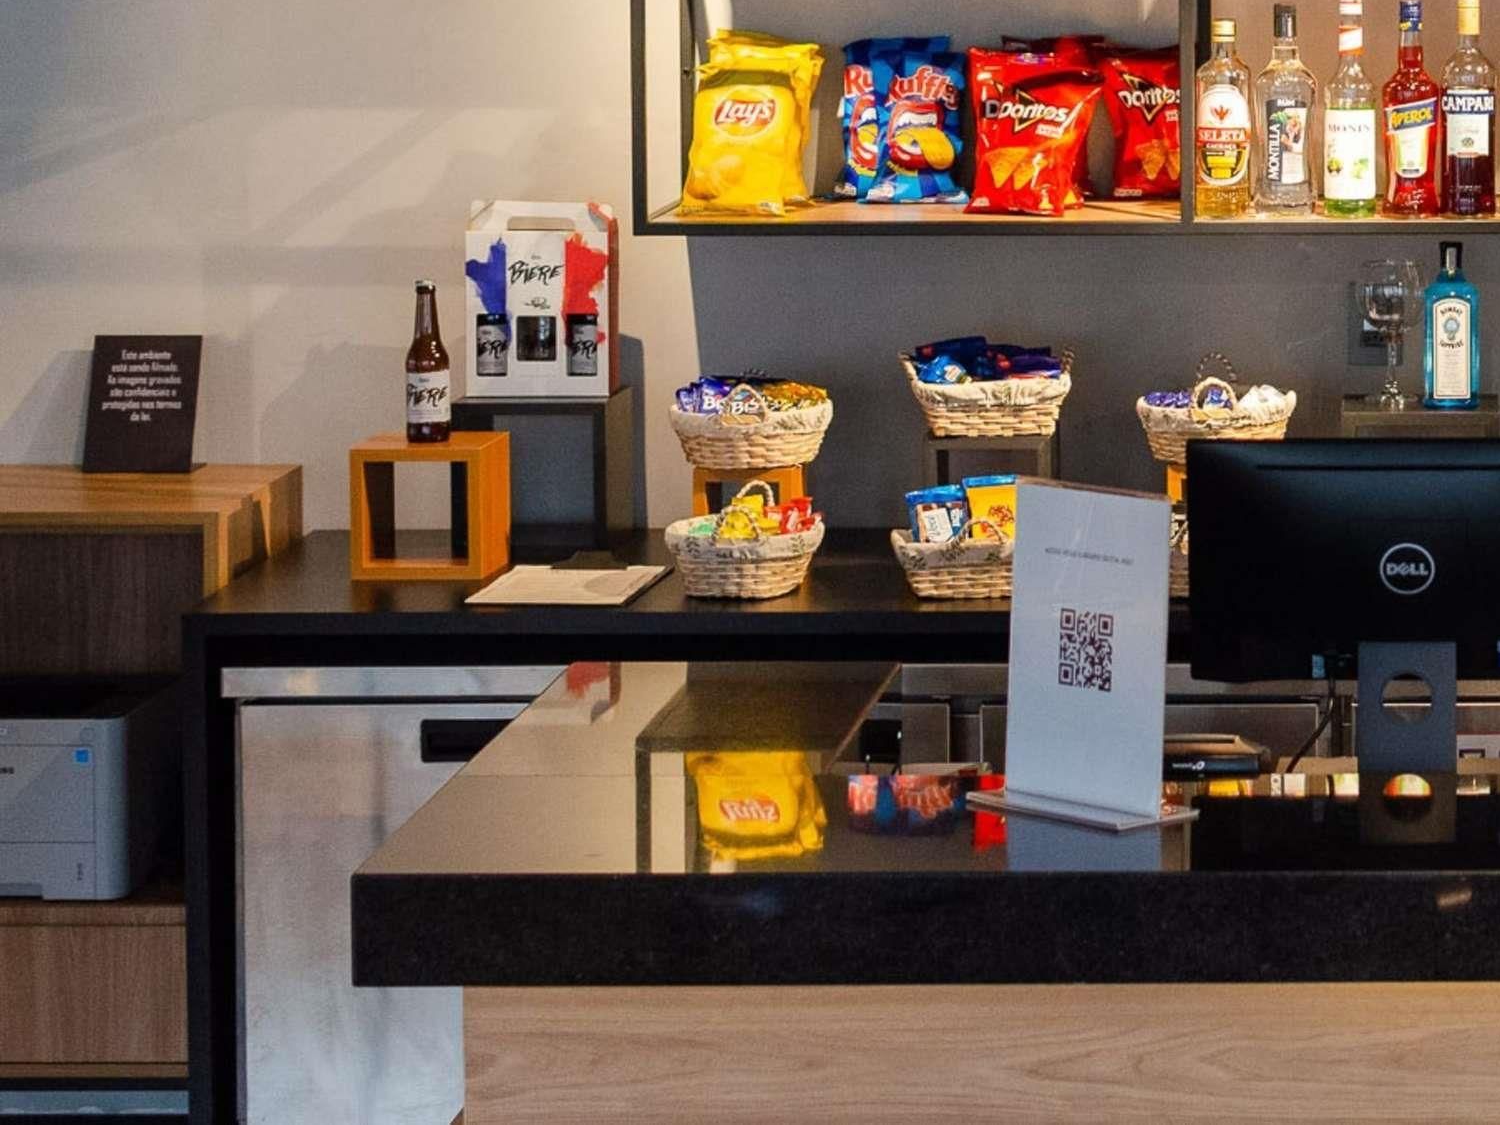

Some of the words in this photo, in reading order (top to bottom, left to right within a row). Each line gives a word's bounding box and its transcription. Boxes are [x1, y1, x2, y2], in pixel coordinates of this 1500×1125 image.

[1442, 95, 1494, 111] CAMPARI
[717, 100, 774, 125] Lay's
[1391, 107, 1433, 127] APEROL
[1199, 128, 1246, 142] SELETA
[1268, 123, 1280, 180] MONTILLA
[1385, 562, 1428, 576] DELL
